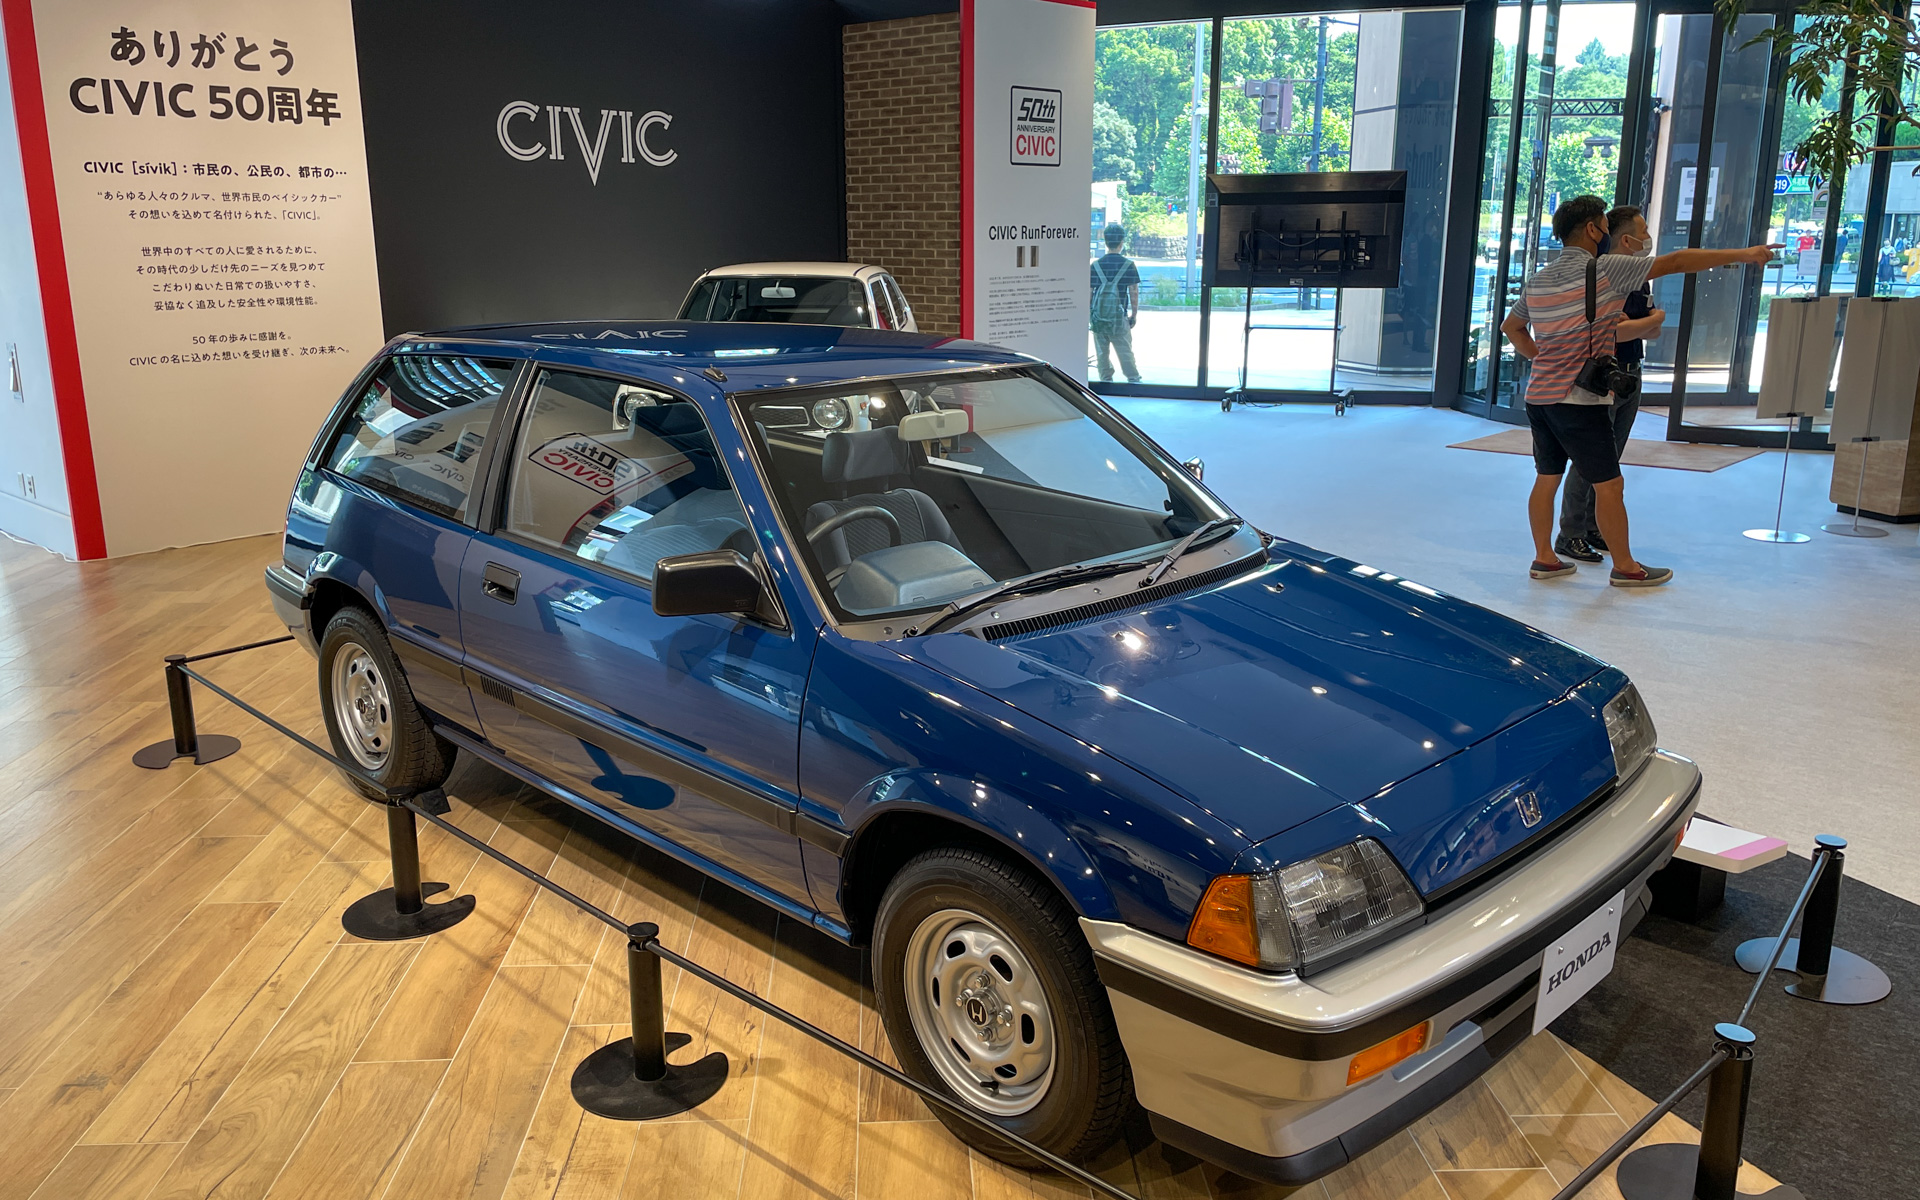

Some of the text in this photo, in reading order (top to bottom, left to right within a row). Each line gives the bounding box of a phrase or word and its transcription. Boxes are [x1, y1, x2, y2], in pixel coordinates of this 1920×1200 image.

[110, 25, 295, 77] ありがとう
[68, 77, 342, 127] CIVIC 50周年
[1017, 97, 1056, 123] 50th
[1016, 124, 1055, 134] ANNIVERSARY
[496, 100, 679, 187] CIVIC
[1015, 134, 1056, 157] CIVIC
[83, 161, 124, 174] CIVIC
[988, 224, 1079, 241] CIVIC RunForever.
[141, 245, 319, 258] 世界中のすべての人に愛されるために、
[135, 262, 326, 276] その時代の少しだけ先のニーズを見つめて
[152, 279, 317, 294] こだわりぬいた日常での扱いやすさ、
[1546, 931, 1612, 995] HONDA
